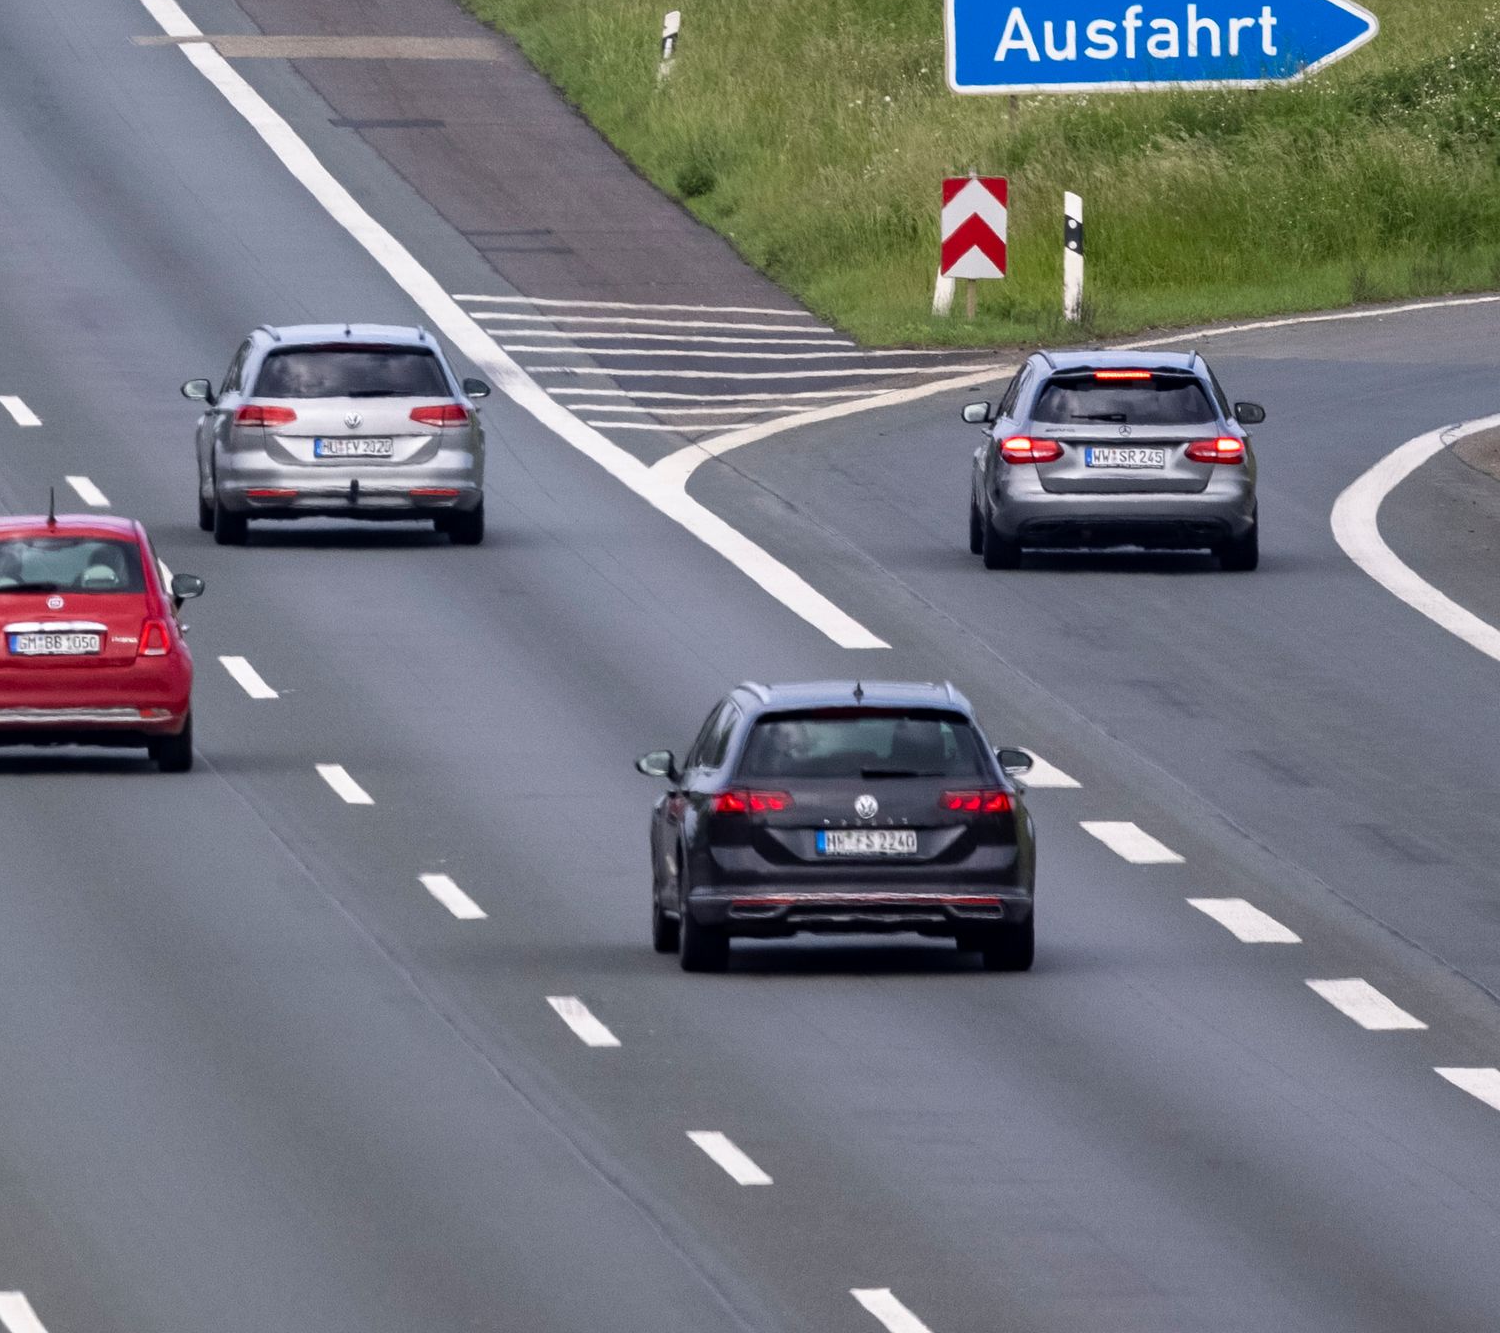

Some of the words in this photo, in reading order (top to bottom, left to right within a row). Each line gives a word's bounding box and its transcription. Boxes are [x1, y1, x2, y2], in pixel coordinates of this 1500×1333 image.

[994, 4, 1278, 62] Ausfahrt
[323, 440, 338, 453] HU
[1093, 450, 1111, 462] WW
[1119, 450, 1139, 462] SR
[1141, 450, 1163, 463] 245
[19, 635, 37, 649] GM
